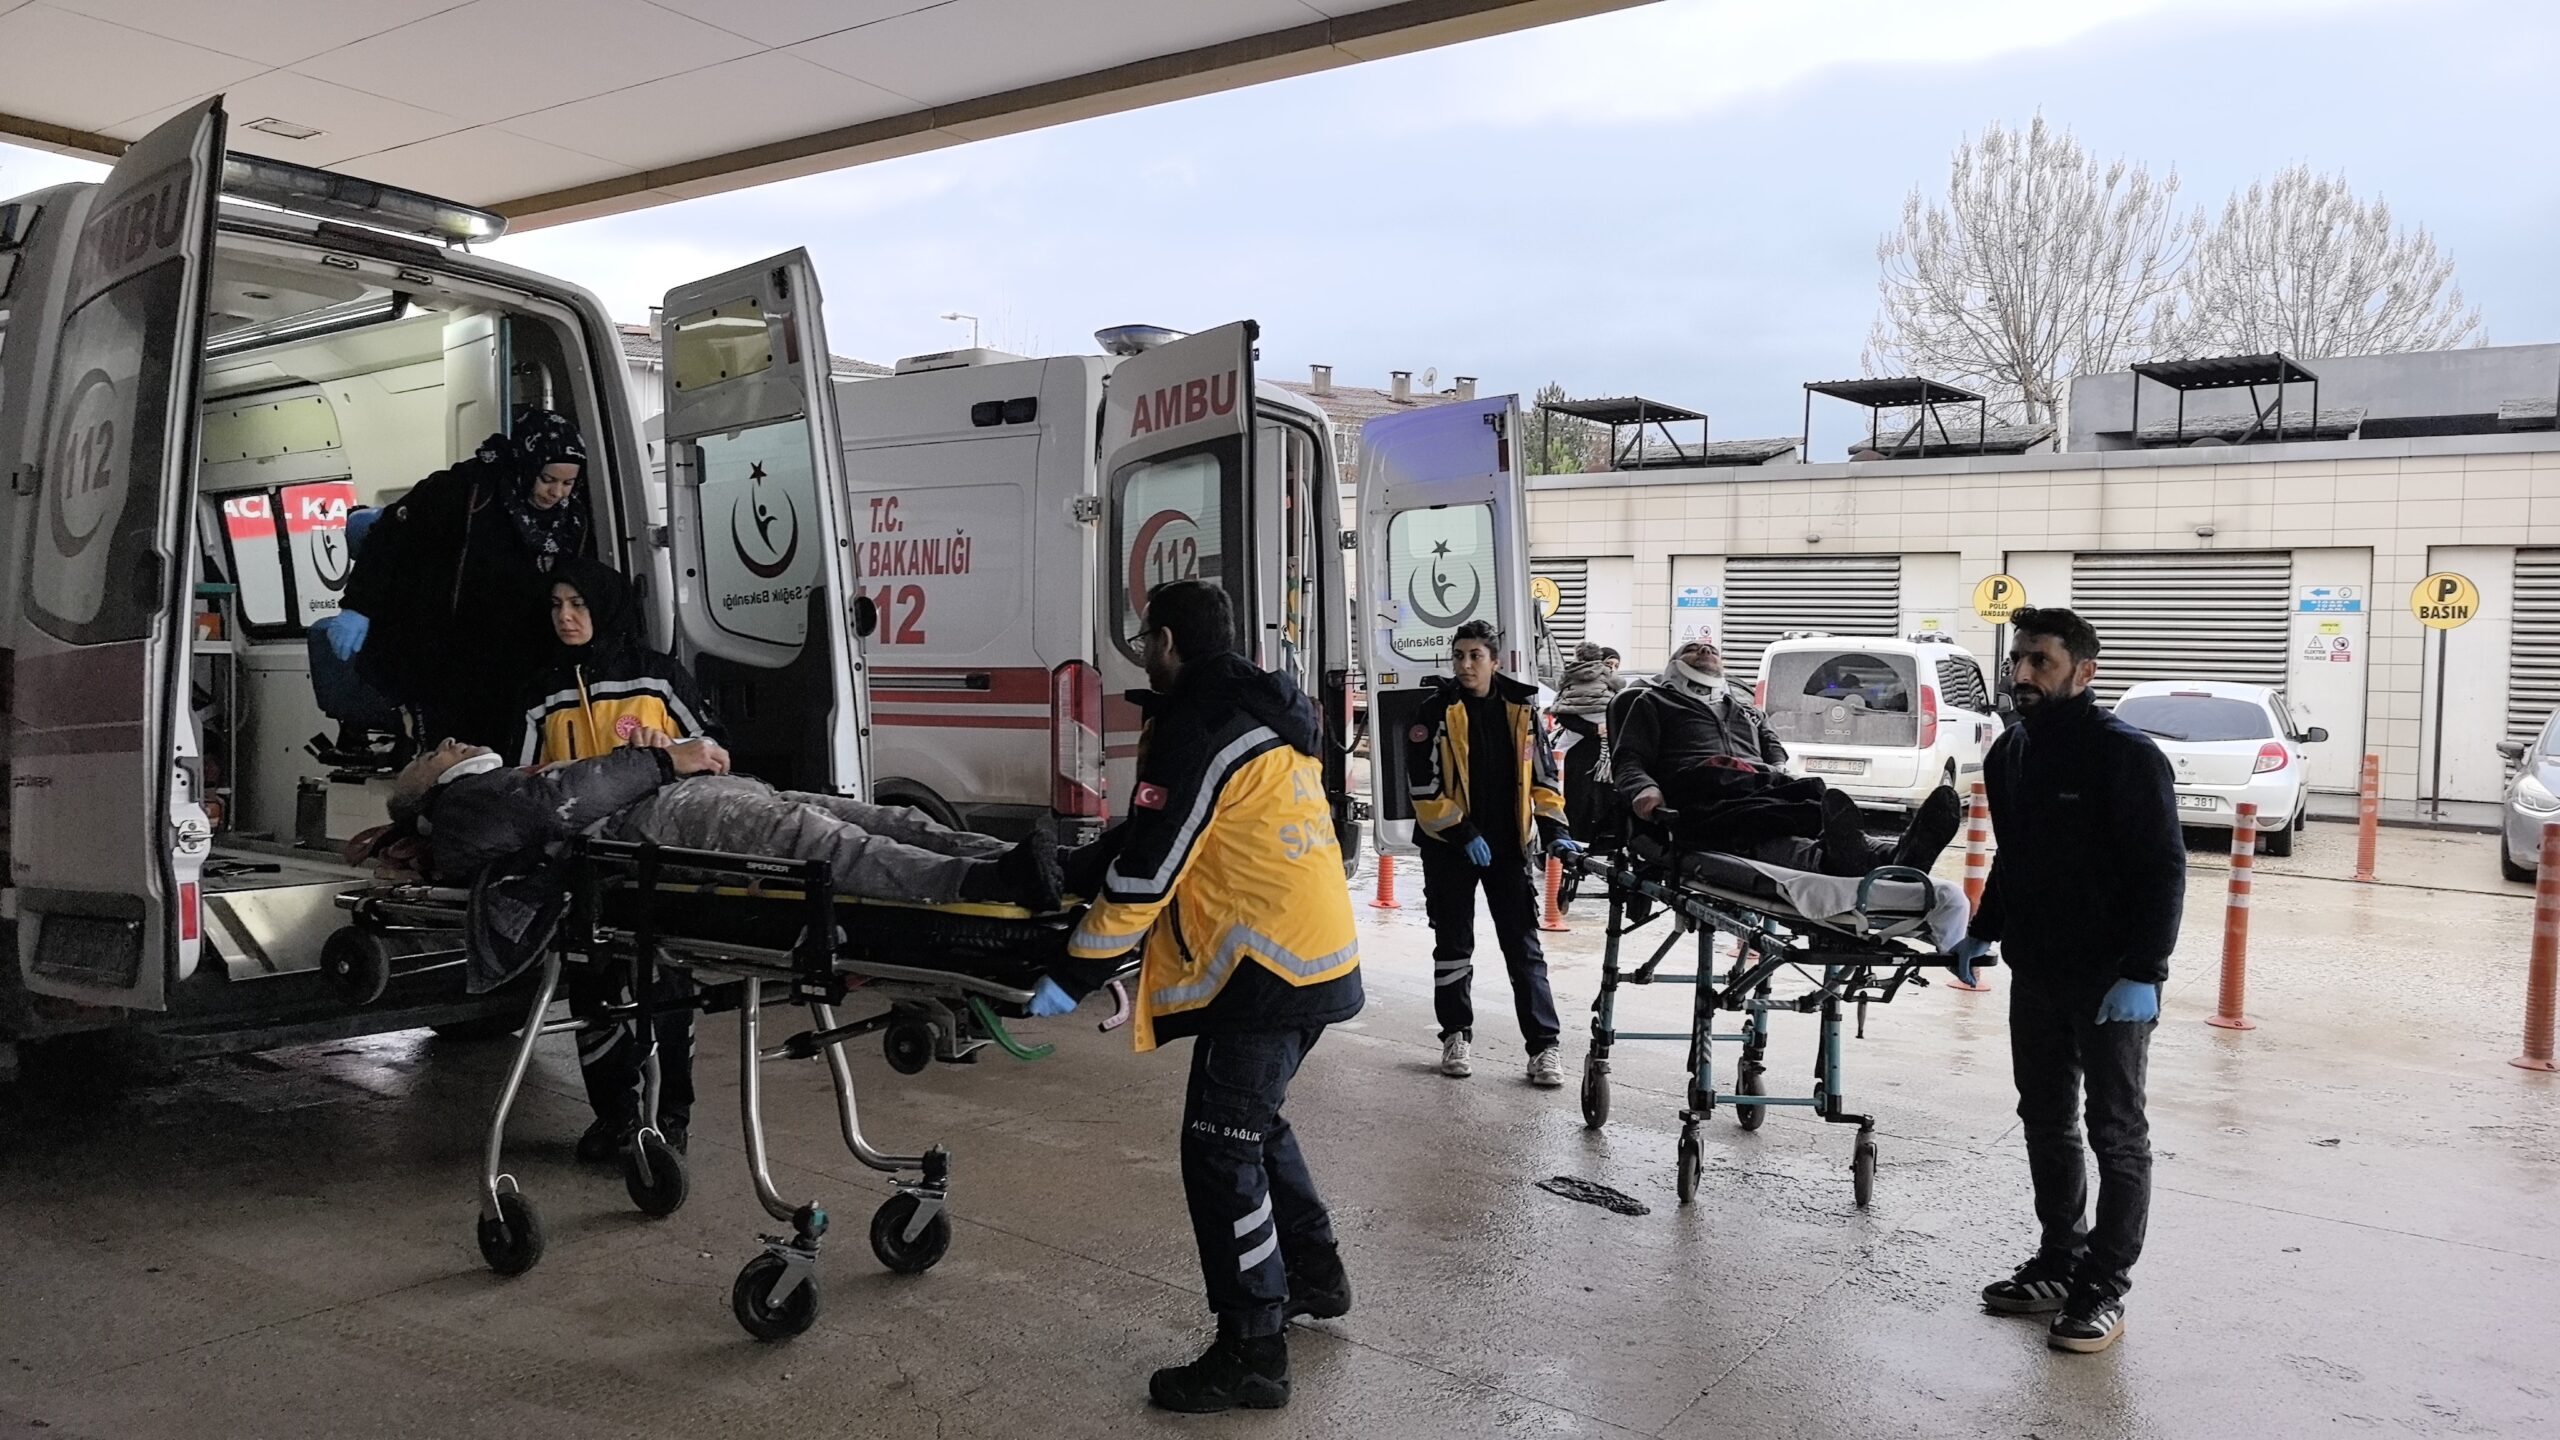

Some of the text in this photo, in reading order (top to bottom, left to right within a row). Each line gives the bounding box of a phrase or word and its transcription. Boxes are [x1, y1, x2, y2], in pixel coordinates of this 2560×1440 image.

[1130, 369, 1237, 438] AMBU
[66, 420, 114, 499] 112
[870, 496, 903, 533] T.C.
[868, 528, 971, 577] BAKANLIĞI
[1152, 536, 1198, 584] 112
[1993, 580, 2008, 600] P
[2437, 578, 2457, 602] P
[2419, 605, 2468, 619] BASIN
[2194, 797, 2213, 807] 381
